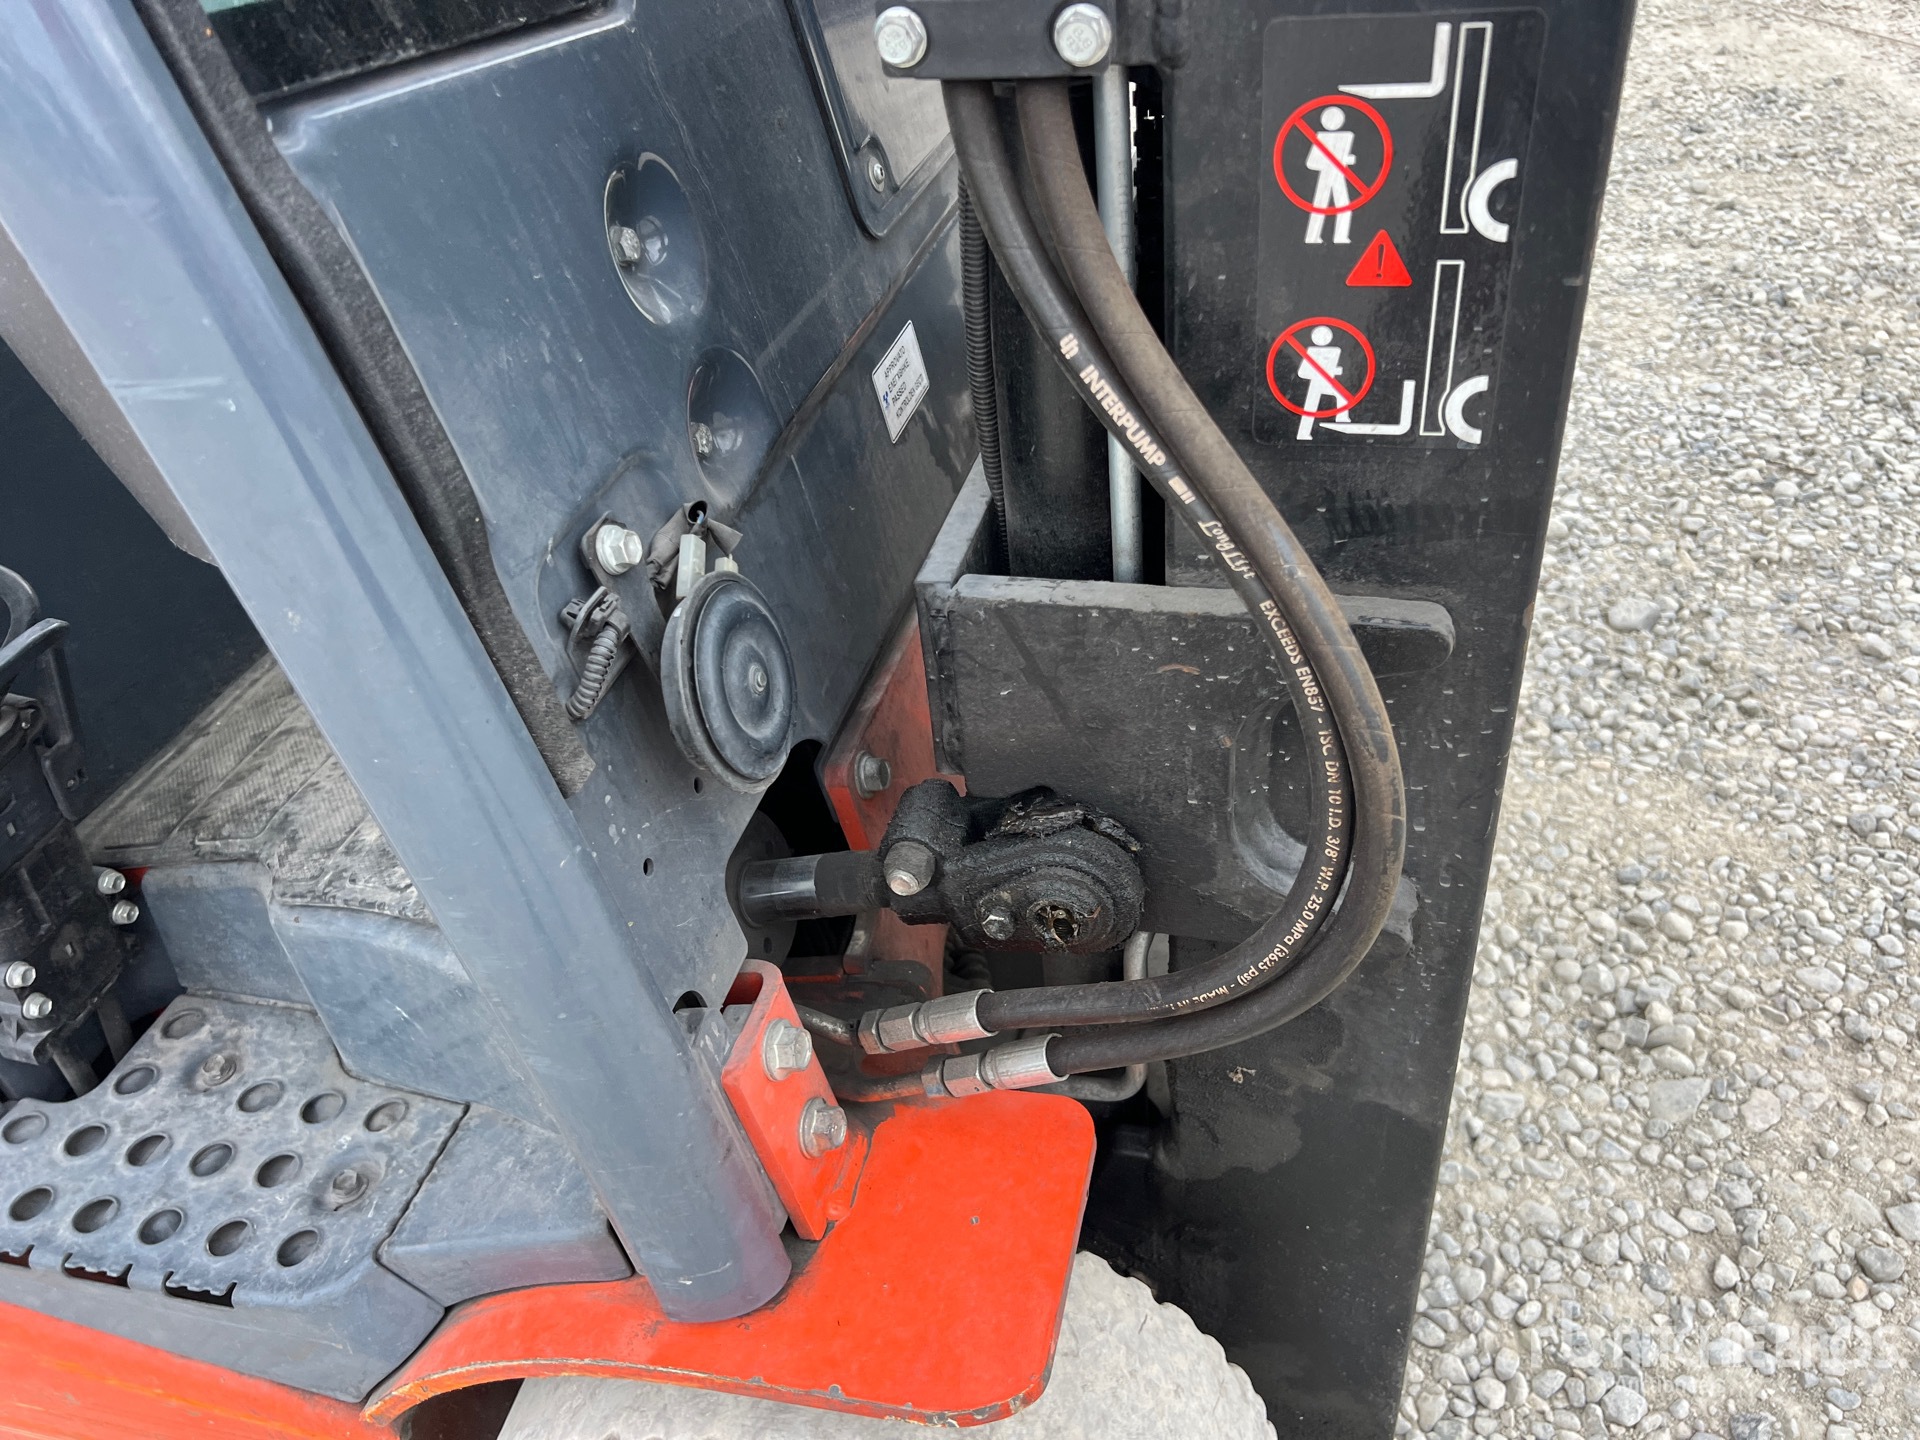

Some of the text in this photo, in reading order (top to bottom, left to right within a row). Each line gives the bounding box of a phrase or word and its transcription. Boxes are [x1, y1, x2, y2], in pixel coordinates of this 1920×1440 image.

[1079, 364, 1166, 467] INTERPUMP
[1259, 600, 1302, 665] EXCEEDS
[1295, 666, 1326, 712] EN857
[1318, 729, 1335, 756] 1SC
[1325, 761, 1342, 784] DN
[1328, 790, 1342, 805] 10
[1302, 894, 1323, 921] 25,0
[1283, 919, 1309, 945] MPa
[1258, 943, 1289, 973] (3625
[1237, 965, 1260, 987] psi)
